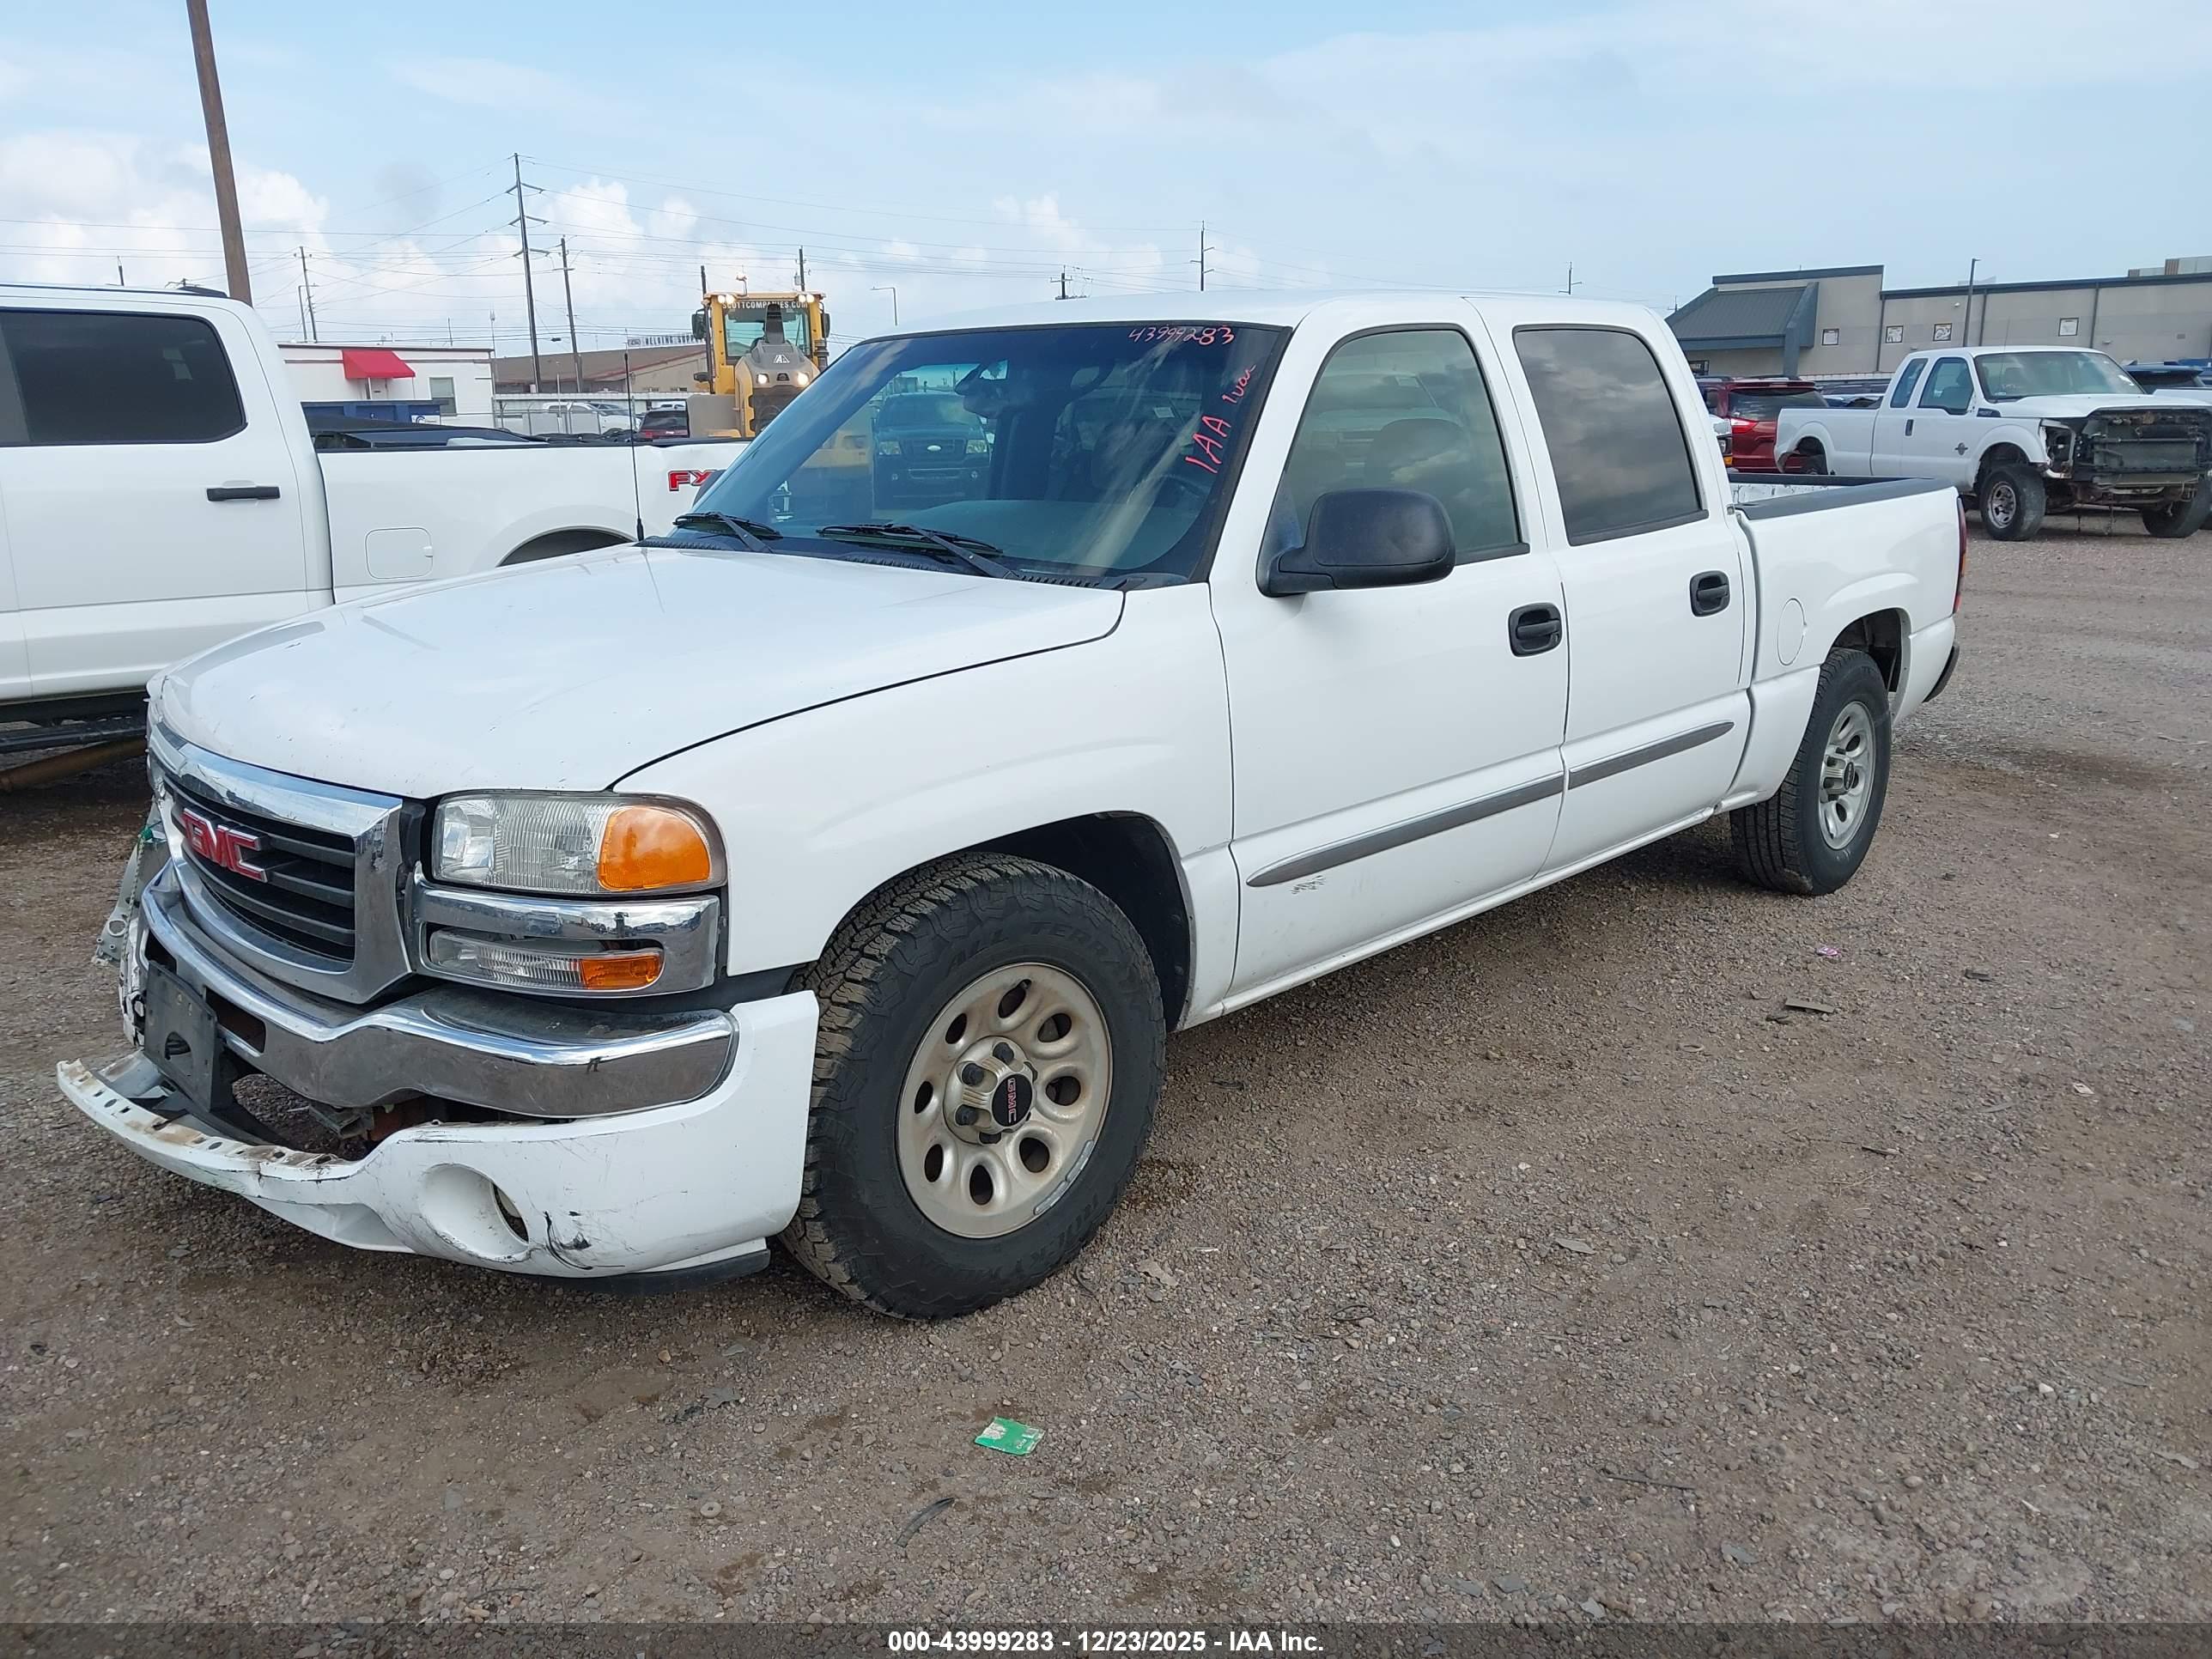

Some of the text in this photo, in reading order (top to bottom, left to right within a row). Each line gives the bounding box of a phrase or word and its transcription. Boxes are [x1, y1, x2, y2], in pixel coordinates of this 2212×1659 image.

[1128, 325, 1234, 345] 43999283
[1185, 416, 1231, 474] IAA
[181, 808, 268, 883] GMC
[1007, 1078, 1017, 1123] GMC
